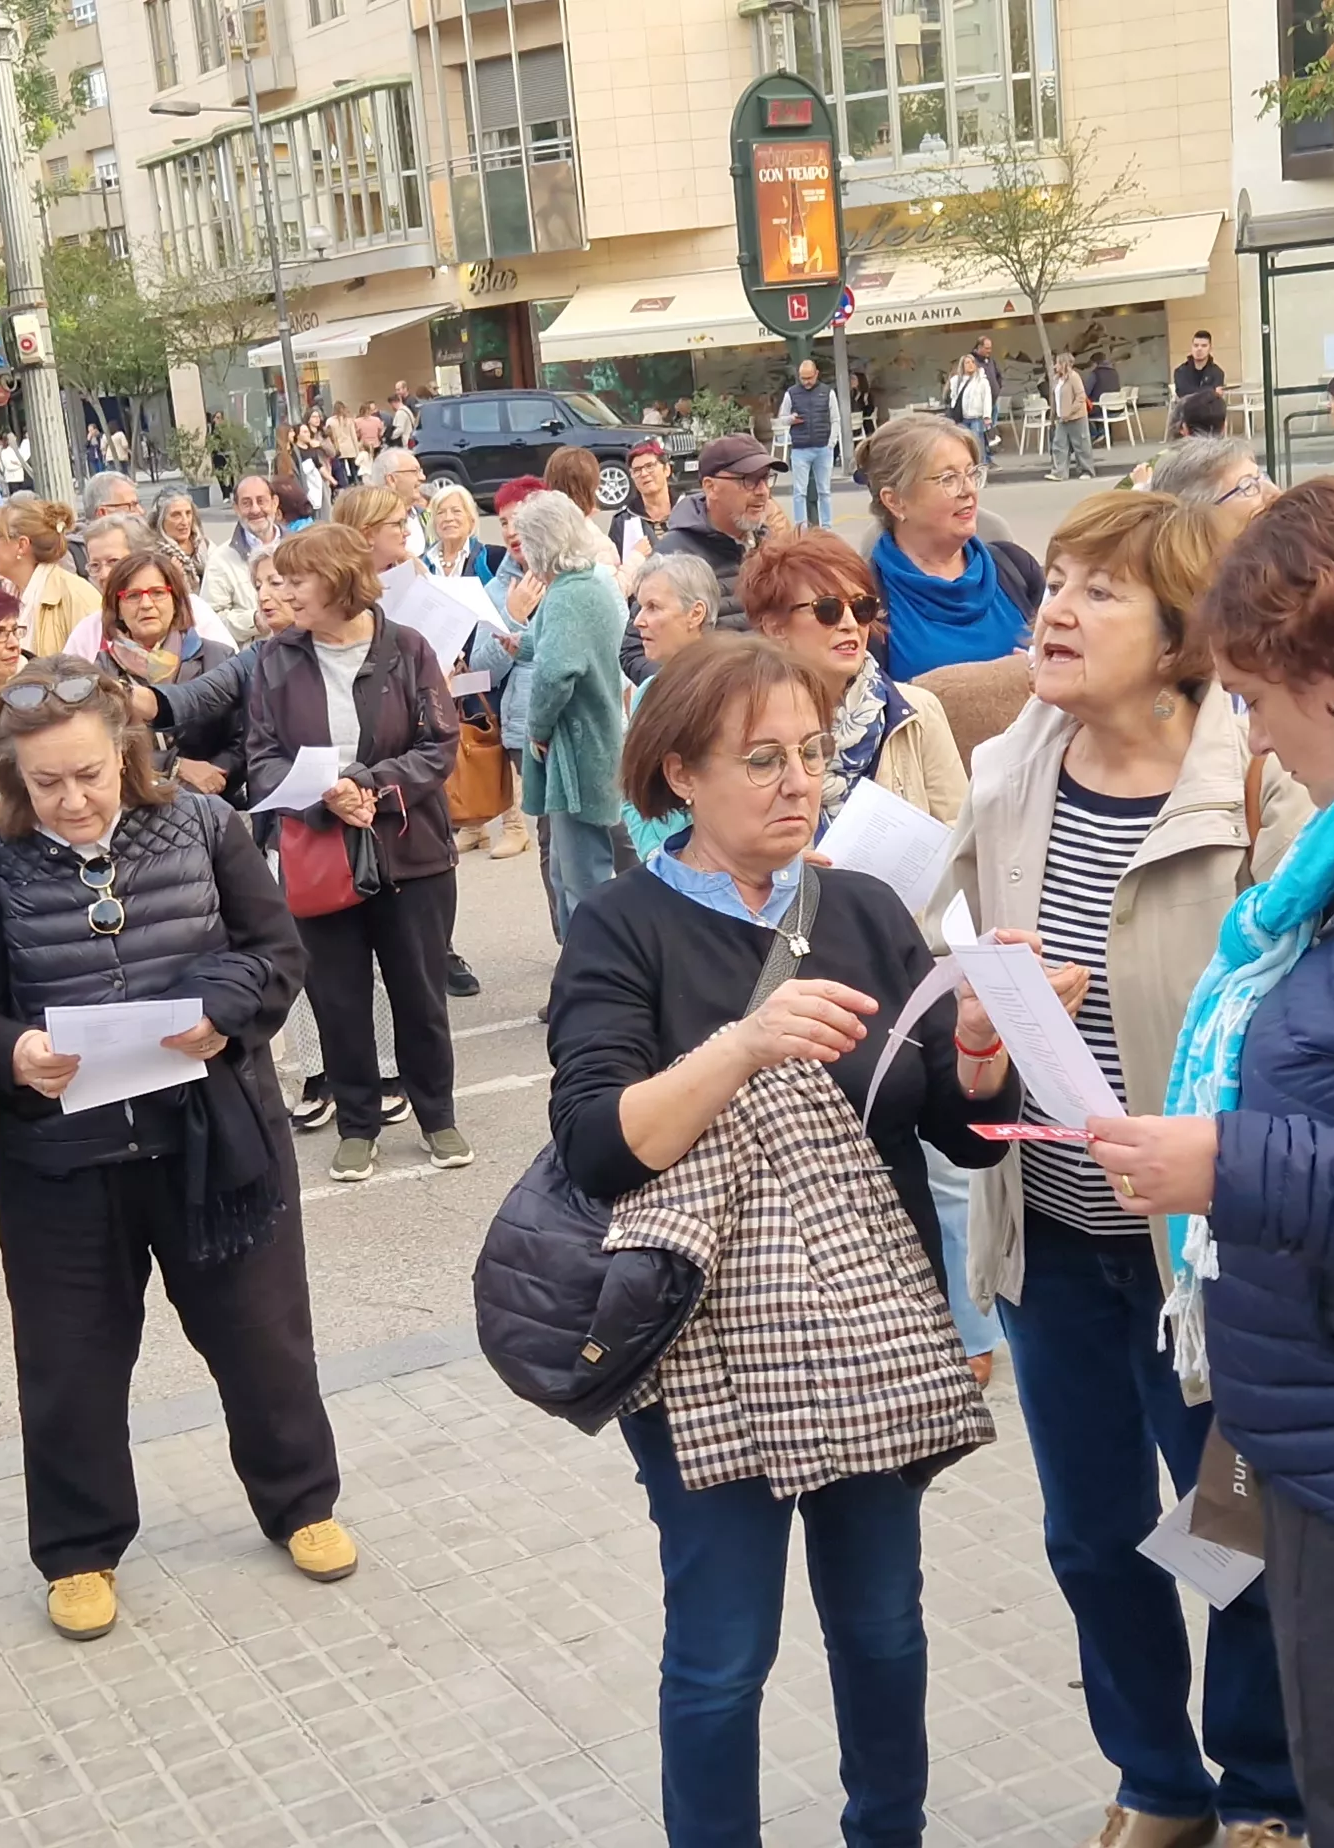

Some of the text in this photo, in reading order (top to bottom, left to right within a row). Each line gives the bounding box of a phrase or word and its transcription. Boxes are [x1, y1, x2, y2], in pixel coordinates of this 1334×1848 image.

[759, 166, 829, 182] CON TIEMPO
[468, 258, 518, 296] Bar
[866, 306, 963, 326] GRANJA ANITA
